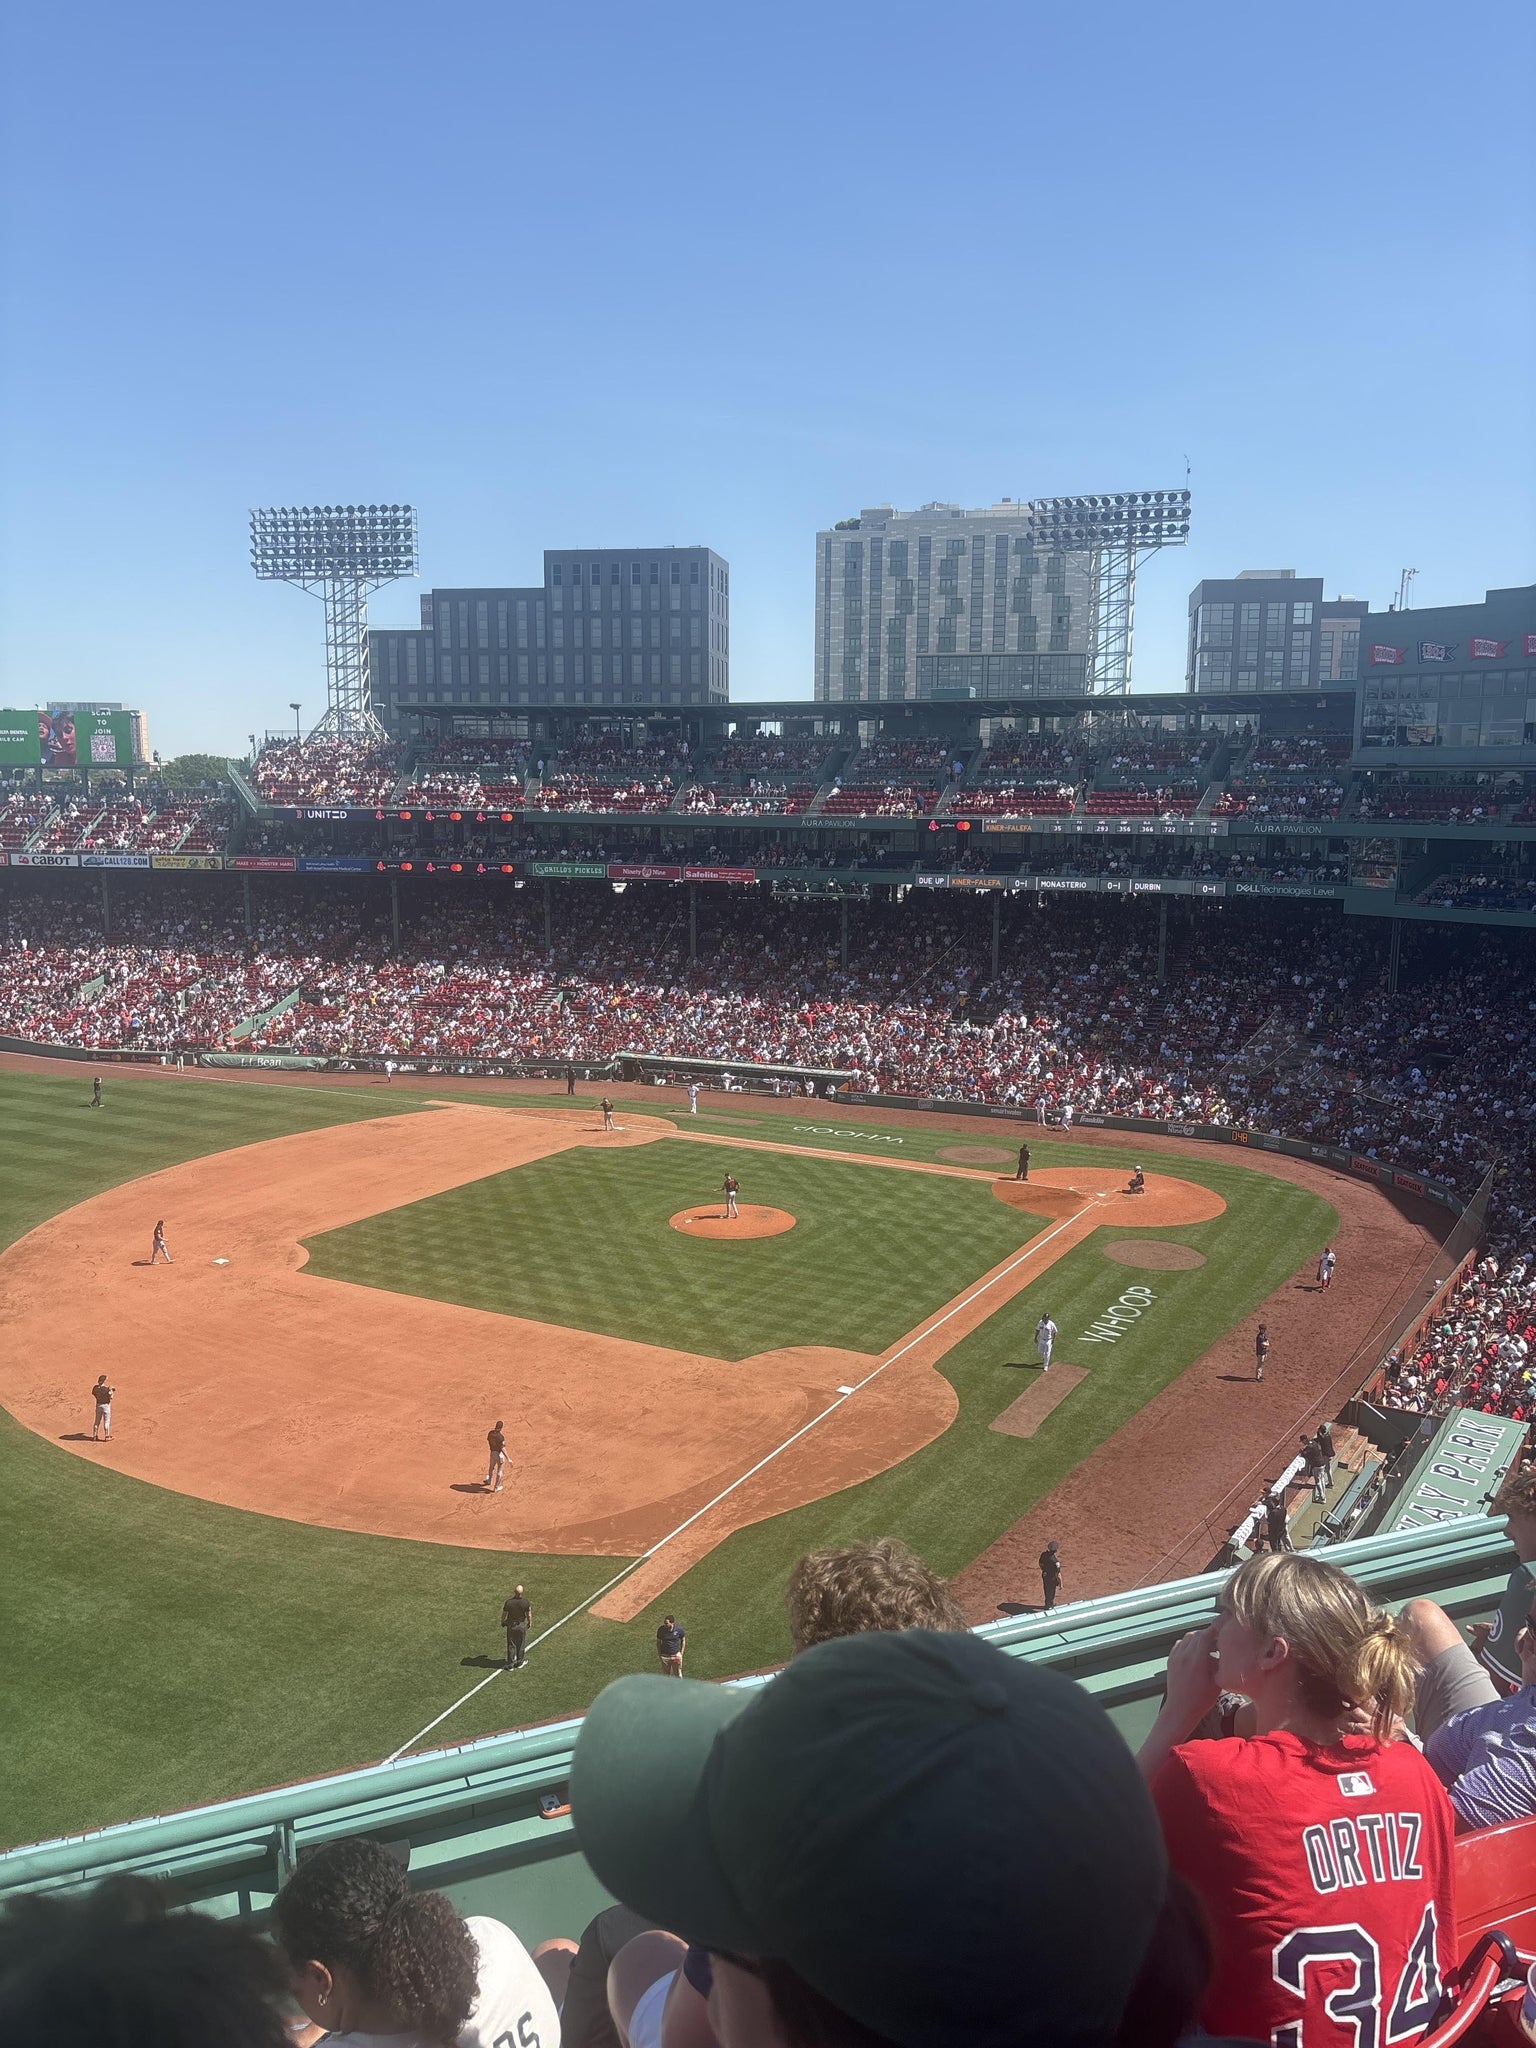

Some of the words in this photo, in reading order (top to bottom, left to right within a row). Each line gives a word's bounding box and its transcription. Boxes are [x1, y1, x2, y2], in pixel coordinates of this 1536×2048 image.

[307, 810, 348, 820] UNITED
[825, 820, 856, 828] PAVILION
[1283, 825, 1322, 834] PAVILION
[574, 867, 603, 875] PICKLES
[918, 877, 933, 885] DUE
[935, 877, 945, 885] UP
[951, 878, 1001, 887] KINER-FALEFA
[1040, 880, 1087, 889] MONASTERIO
[1134, 883, 1161, 891] DURBIN
[1236, 884, 1260, 893] DELL
[1260, 885, 1312, 897] Technologies
[1313, 886, 1335, 897] Level
[793, 1125, 903, 1144] WHOOP
[1077, 1286, 1158, 1343] WHOOP
[1430, 1416, 1506, 1486] PARK
[1303, 1812, 1423, 1894] ORTIZ
[1271, 1900, 1443, 2048] 34
